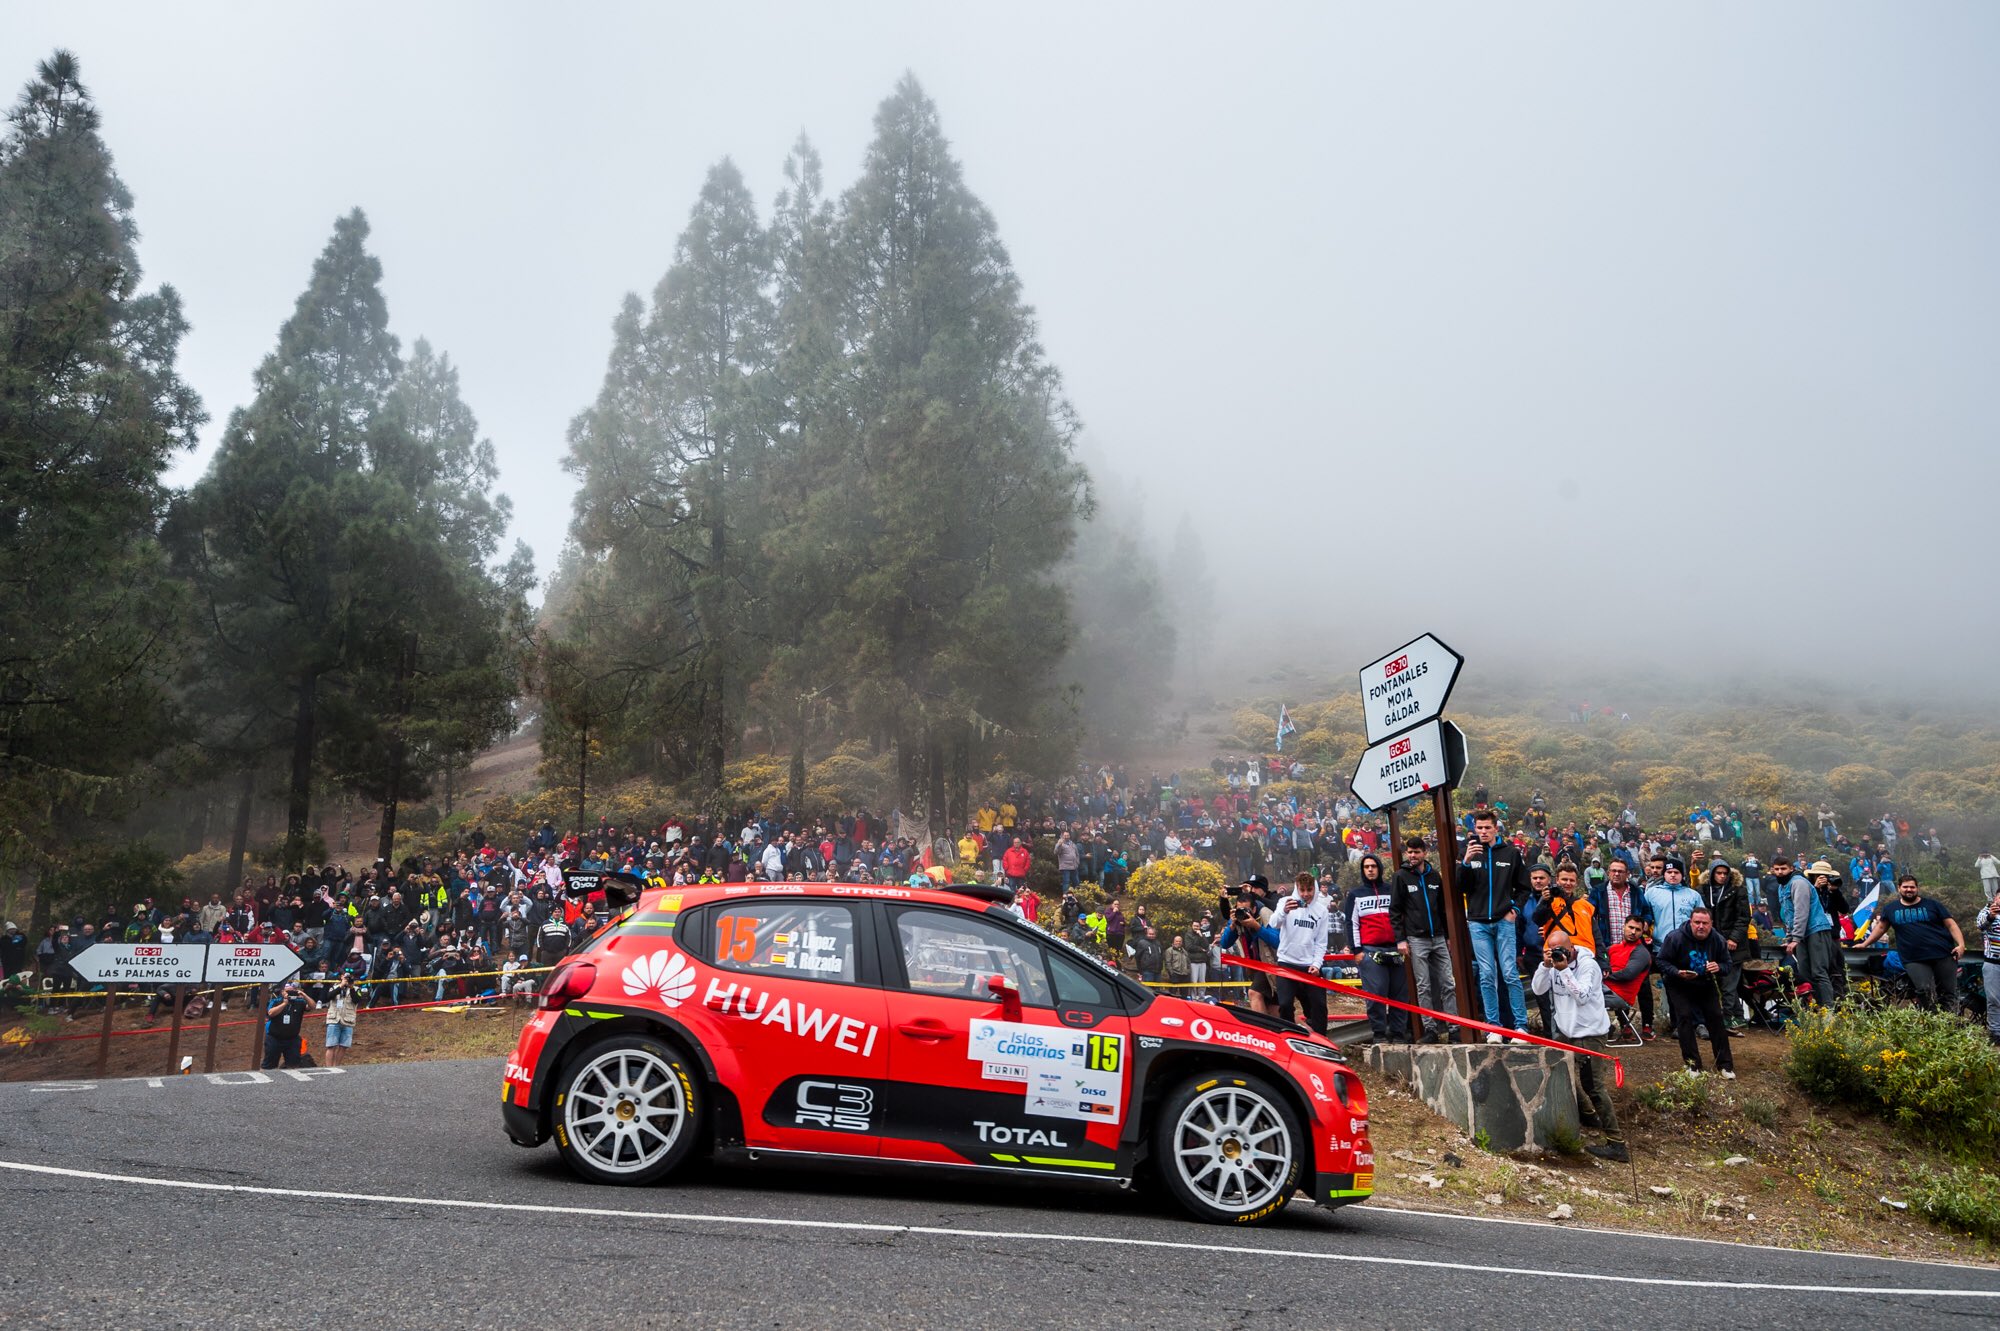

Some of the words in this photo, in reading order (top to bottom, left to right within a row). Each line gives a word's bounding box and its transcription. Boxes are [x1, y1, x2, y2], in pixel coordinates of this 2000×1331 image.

[1385, 657, 1407, 676] GC-70
[1369, 661, 1429, 701] FONTANALES
[1387, 687, 1413, 708] MOYA
[1384, 700, 1420, 727] GÁLDAR
[1390, 740, 1410, 757] GC-21
[1380, 750, 1427, 779] ARTENARA
[1388, 772, 1422, 794] TEJEDA
[1293, 919, 1315, 930] PUMA
[716, 915, 759, 963] 15
[115, 957, 179, 966] VALLESECO
[217, 958, 275, 966] ARTENARA
[98, 969, 119, 977] LAS
[125, 969, 170, 977] PALMAS
[176, 970, 191, 978] GC
[226, 969, 265, 977] TEJEDA
[702, 977, 879, 1057] HUAWEI
[1065, 1010, 1093, 1024] C3
[1011, 1031, 1044, 1046] Islas
[1215, 1030, 1276, 1051] vodafone
[997, 1040, 1066, 1060] Canarias
[1089, 1035, 1118, 1072] 15
[988, 1065, 1025, 1076] TURINI
[796, 1080, 874, 1116] C3
[973, 1120, 1068, 1148] TOTAL
